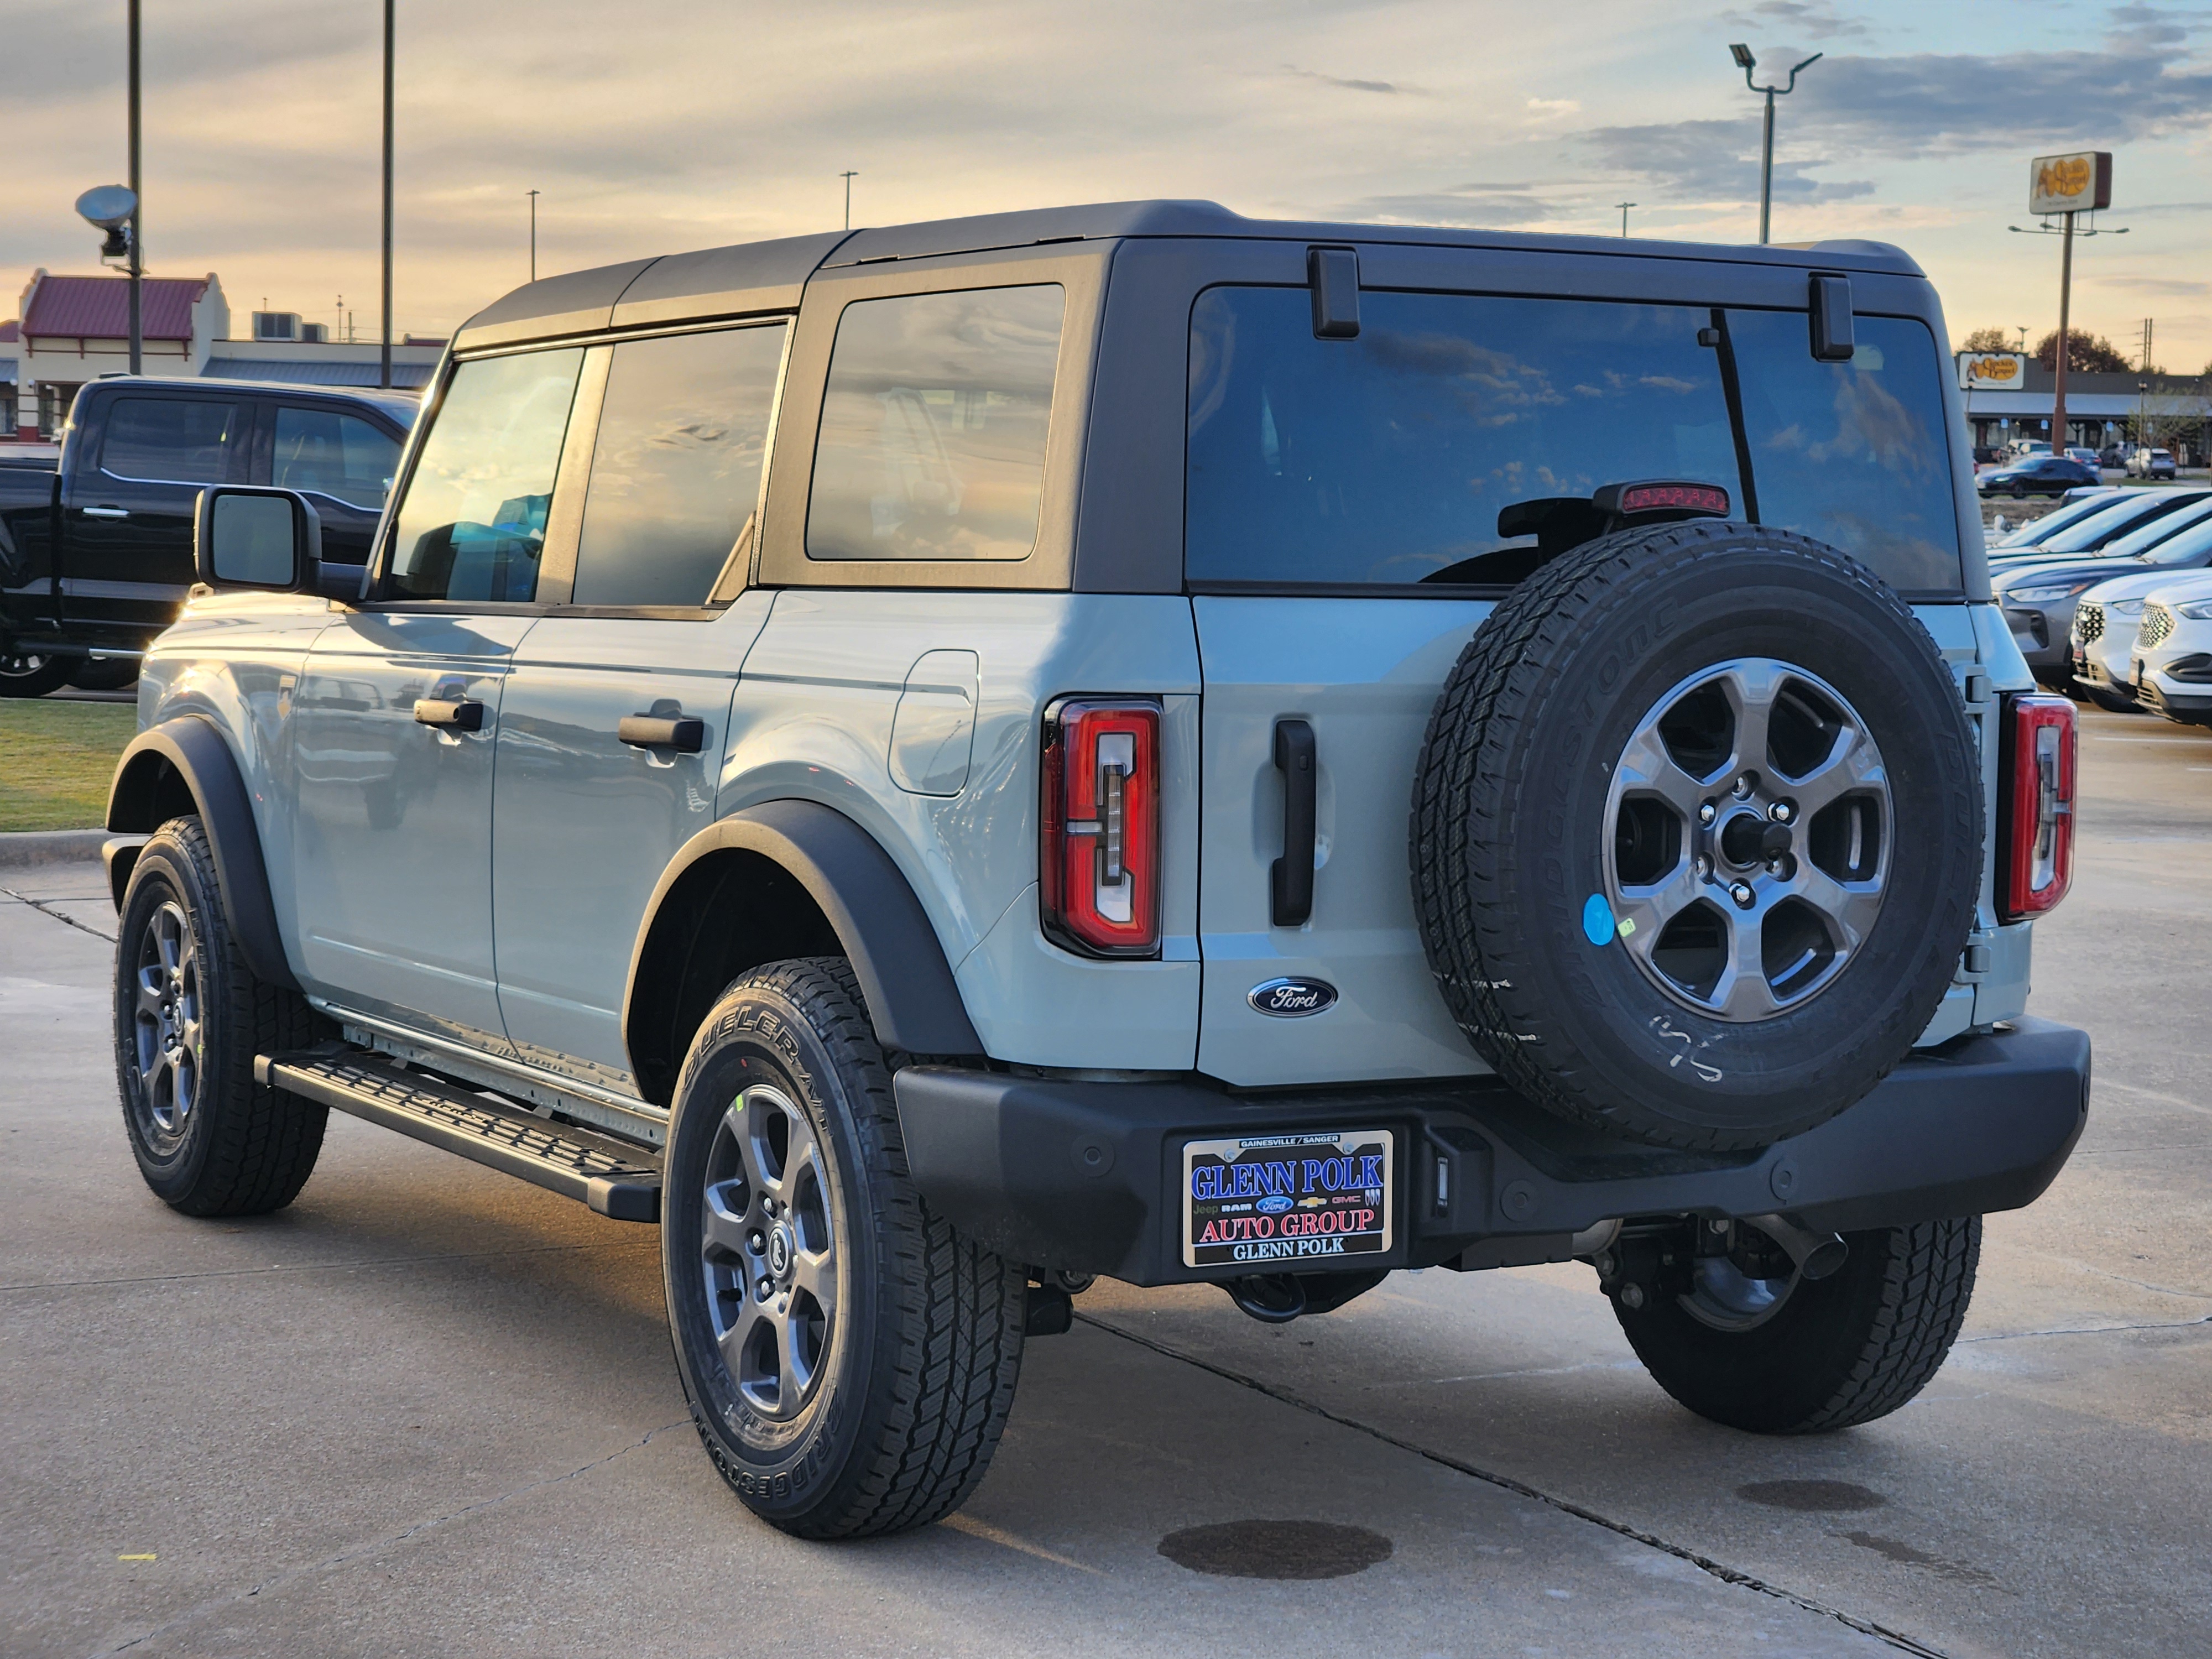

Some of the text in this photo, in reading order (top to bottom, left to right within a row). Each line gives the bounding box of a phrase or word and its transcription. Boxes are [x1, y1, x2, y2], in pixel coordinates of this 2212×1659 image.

[1270, 986, 1318, 1008] Ford
[685, 1005, 800, 1091] DUELER
[1191, 1155, 1383, 1200] GLENN POLK
[1193, 1204, 1218, 1215] Jeep
[1222, 1203, 1252, 1212] RAM
[1332, 1196, 1361, 1204] GMC
[1199, 1209, 1374, 1243] AUTO GROUP
[1233, 1238, 1344, 1260] GLENN POLK
